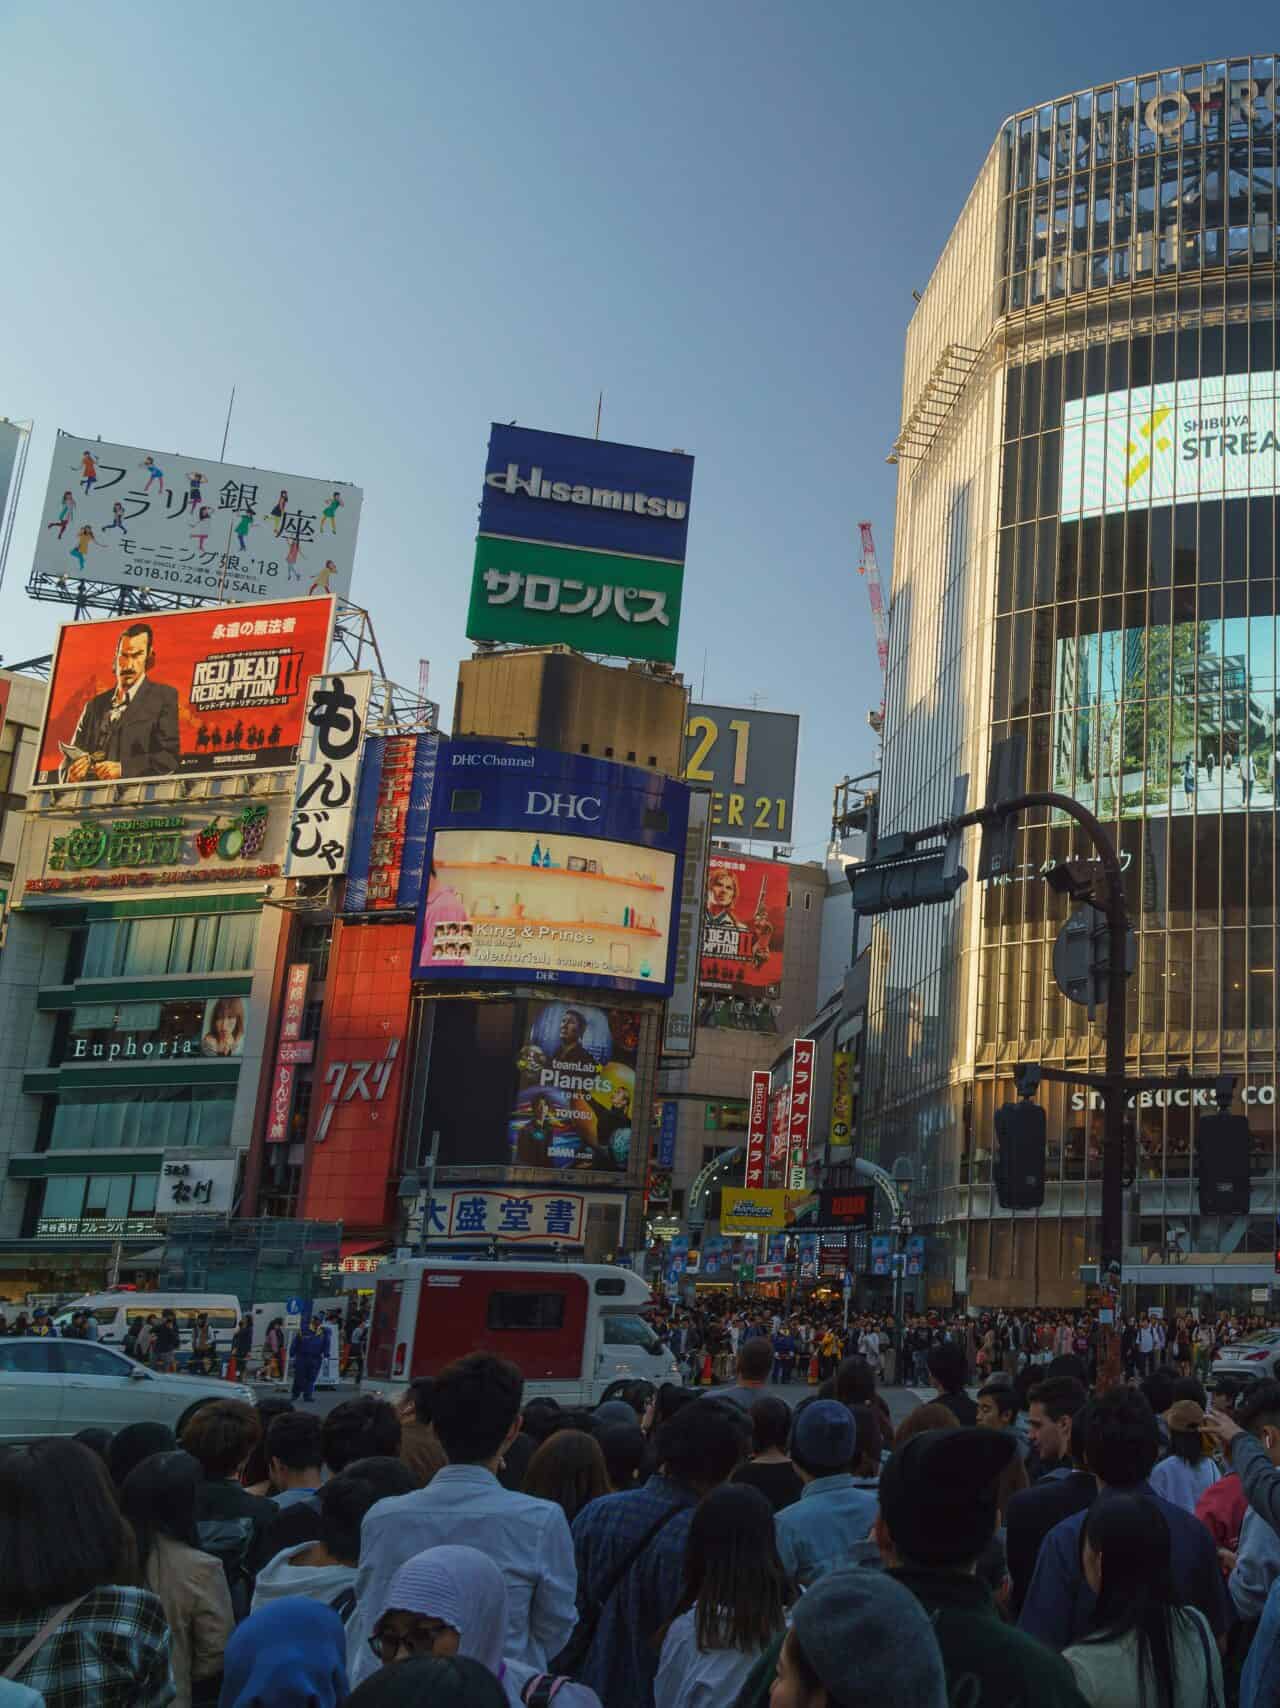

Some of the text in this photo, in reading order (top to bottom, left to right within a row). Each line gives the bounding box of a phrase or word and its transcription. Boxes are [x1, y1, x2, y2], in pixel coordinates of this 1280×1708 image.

[1183, 415, 1250, 433] SHIBUYA
[95, 464, 319, 544] フラリ銀座
[485, 463, 686, 520] Hisamitsu
[123, 563, 202, 586] 2018.10.24
[204, 576, 229, 590] ON
[231, 580, 267, 596] SALE
[483, 567, 670, 627] サロンパス
[194, 660, 230, 685] RED
[231, 656, 280, 684] DEAD
[190, 679, 276, 704] REDEMPTION
[451, 754, 535, 768] DHC Channel
[684, 716, 750, 785] 21
[289, 677, 362, 871] もんじゃ
[524, 791, 602, 821] DHC
[753, 796, 786, 830] 21
[475, 923, 596, 944] King & Prince
[708, 928, 739, 945] DEAD
[536, 970, 560, 981] DHC
[73, 1035, 193, 1063] Euphoria
[540, 1069, 612, 1092] Planets
[552, 1059, 595, 1073] teamLab
[313, 1038, 401, 1142] クスリ
[791, 1050, 811, 1126] カラオケ
[418, 1197, 577, 1234] 大盛堂書
